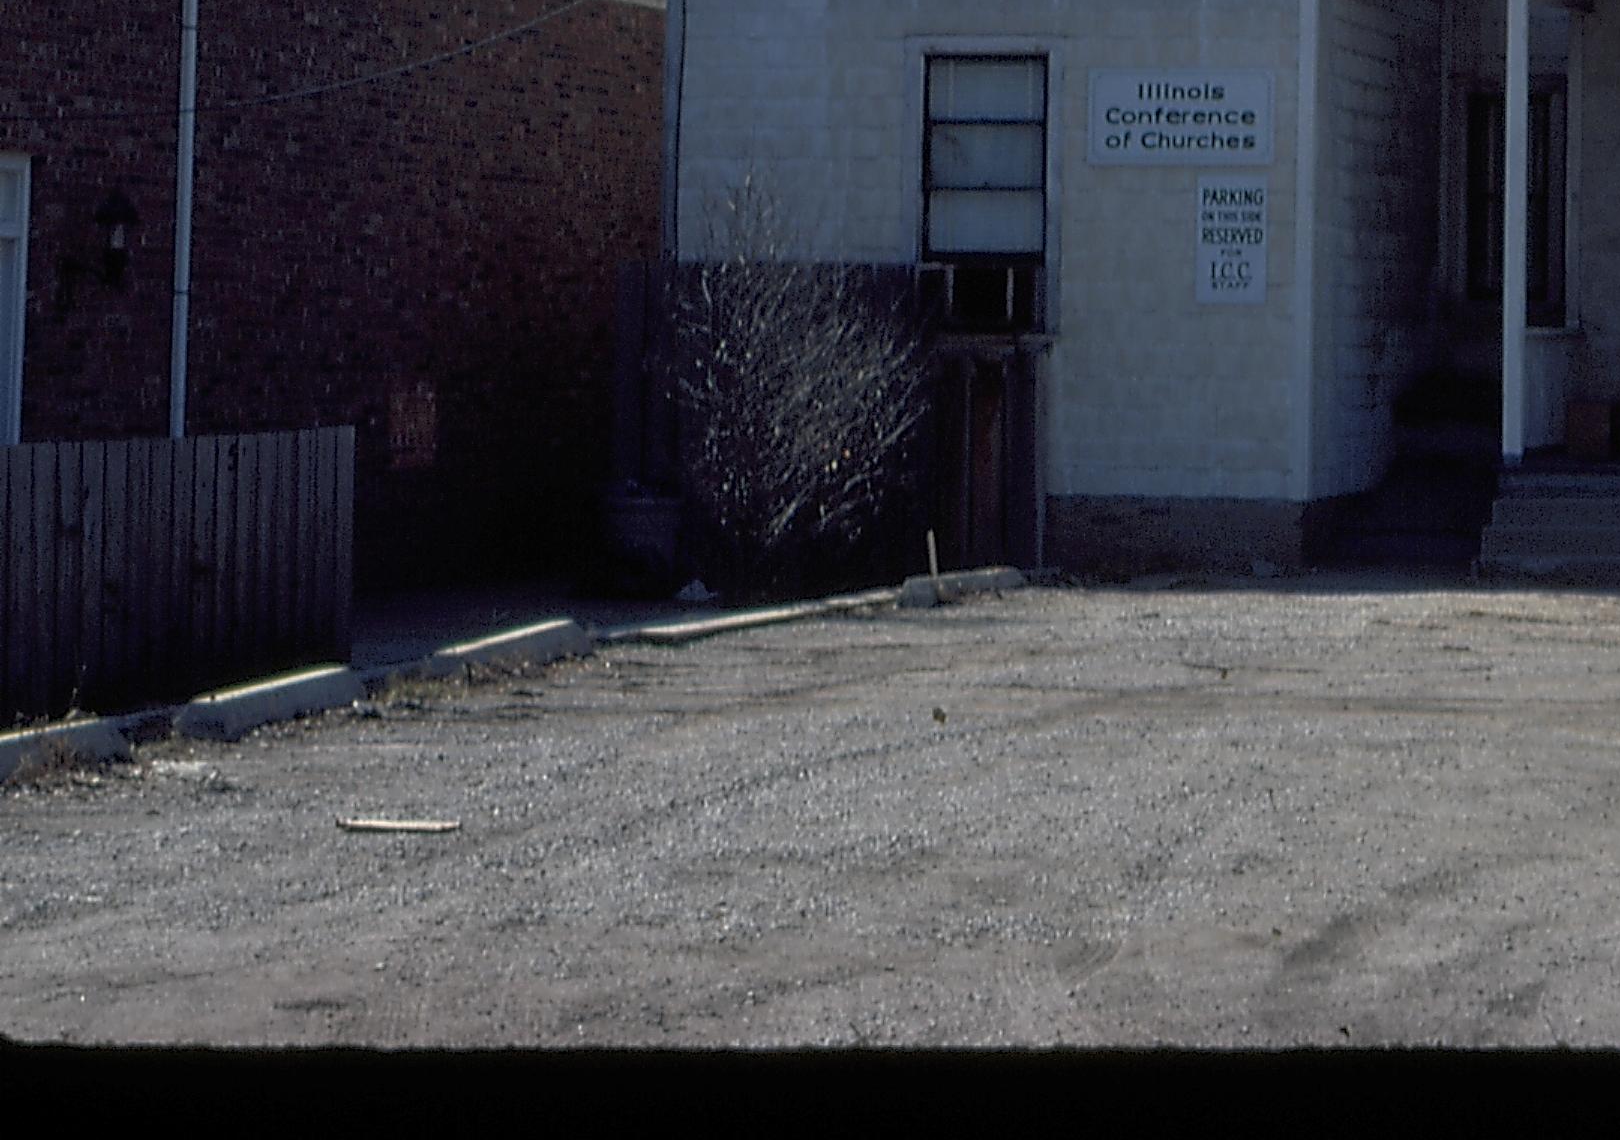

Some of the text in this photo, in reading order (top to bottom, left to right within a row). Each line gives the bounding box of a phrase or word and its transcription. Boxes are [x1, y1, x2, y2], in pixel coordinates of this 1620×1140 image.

[1138, 82, 1224, 100] Illinois
[1105, 108, 1256, 125] Conference
[1105, 131, 1256, 149] of Churches
[1202, 188, 1264, 206] PARKING
[1202, 227, 1264, 245] RESERVED
